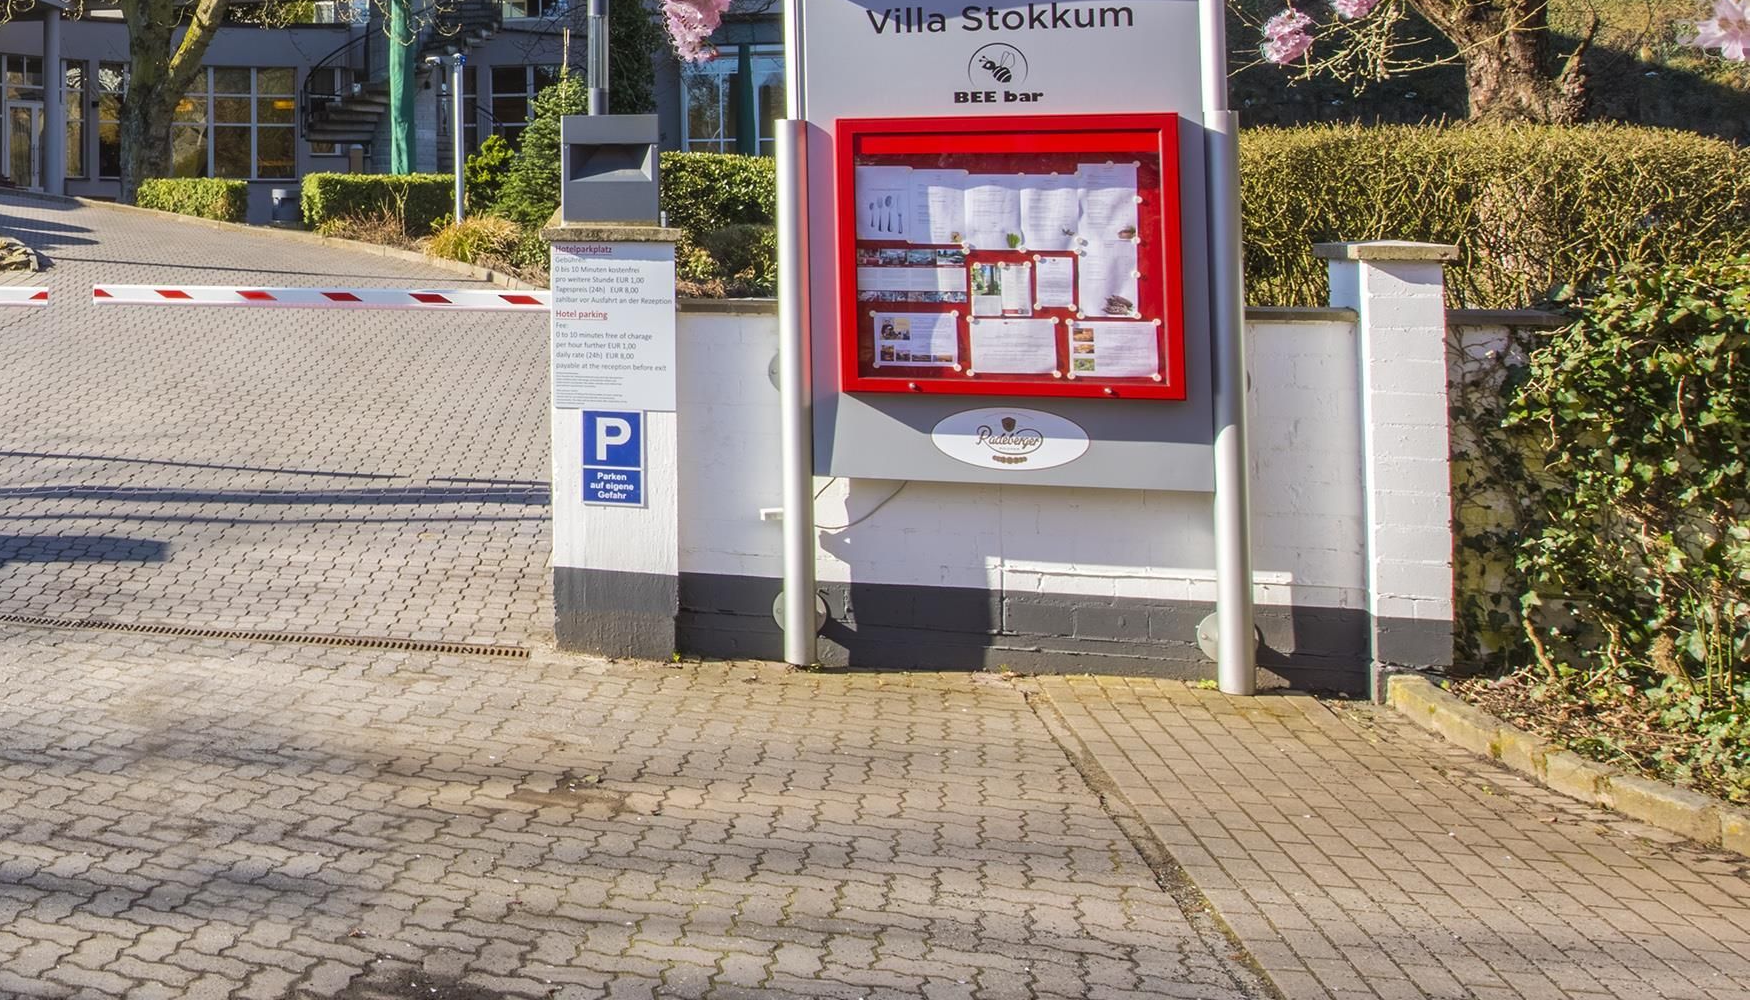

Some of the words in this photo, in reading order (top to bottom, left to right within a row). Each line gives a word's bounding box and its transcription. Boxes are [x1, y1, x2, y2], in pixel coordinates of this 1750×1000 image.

[866, 7, 947, 34] Villa
[961, 1, 1134, 32] Stokkum
[953, 91, 997, 103] BEE
[1004, 90, 1044, 103] bar
[555, 244, 612, 255] Hotelparkplatz
[555, 310, 577, 318] Hotel
[578, 310, 608, 320] parking
[628, 333, 653, 341] charage
[596, 417, 632, 461] P
[975, 425, 1043, 451] Radeberger
[597, 472, 627, 481] Parken
[590, 481, 605, 489] auf
[605, 482, 634, 491] eigene
[597, 491, 627, 499] Gefahr
